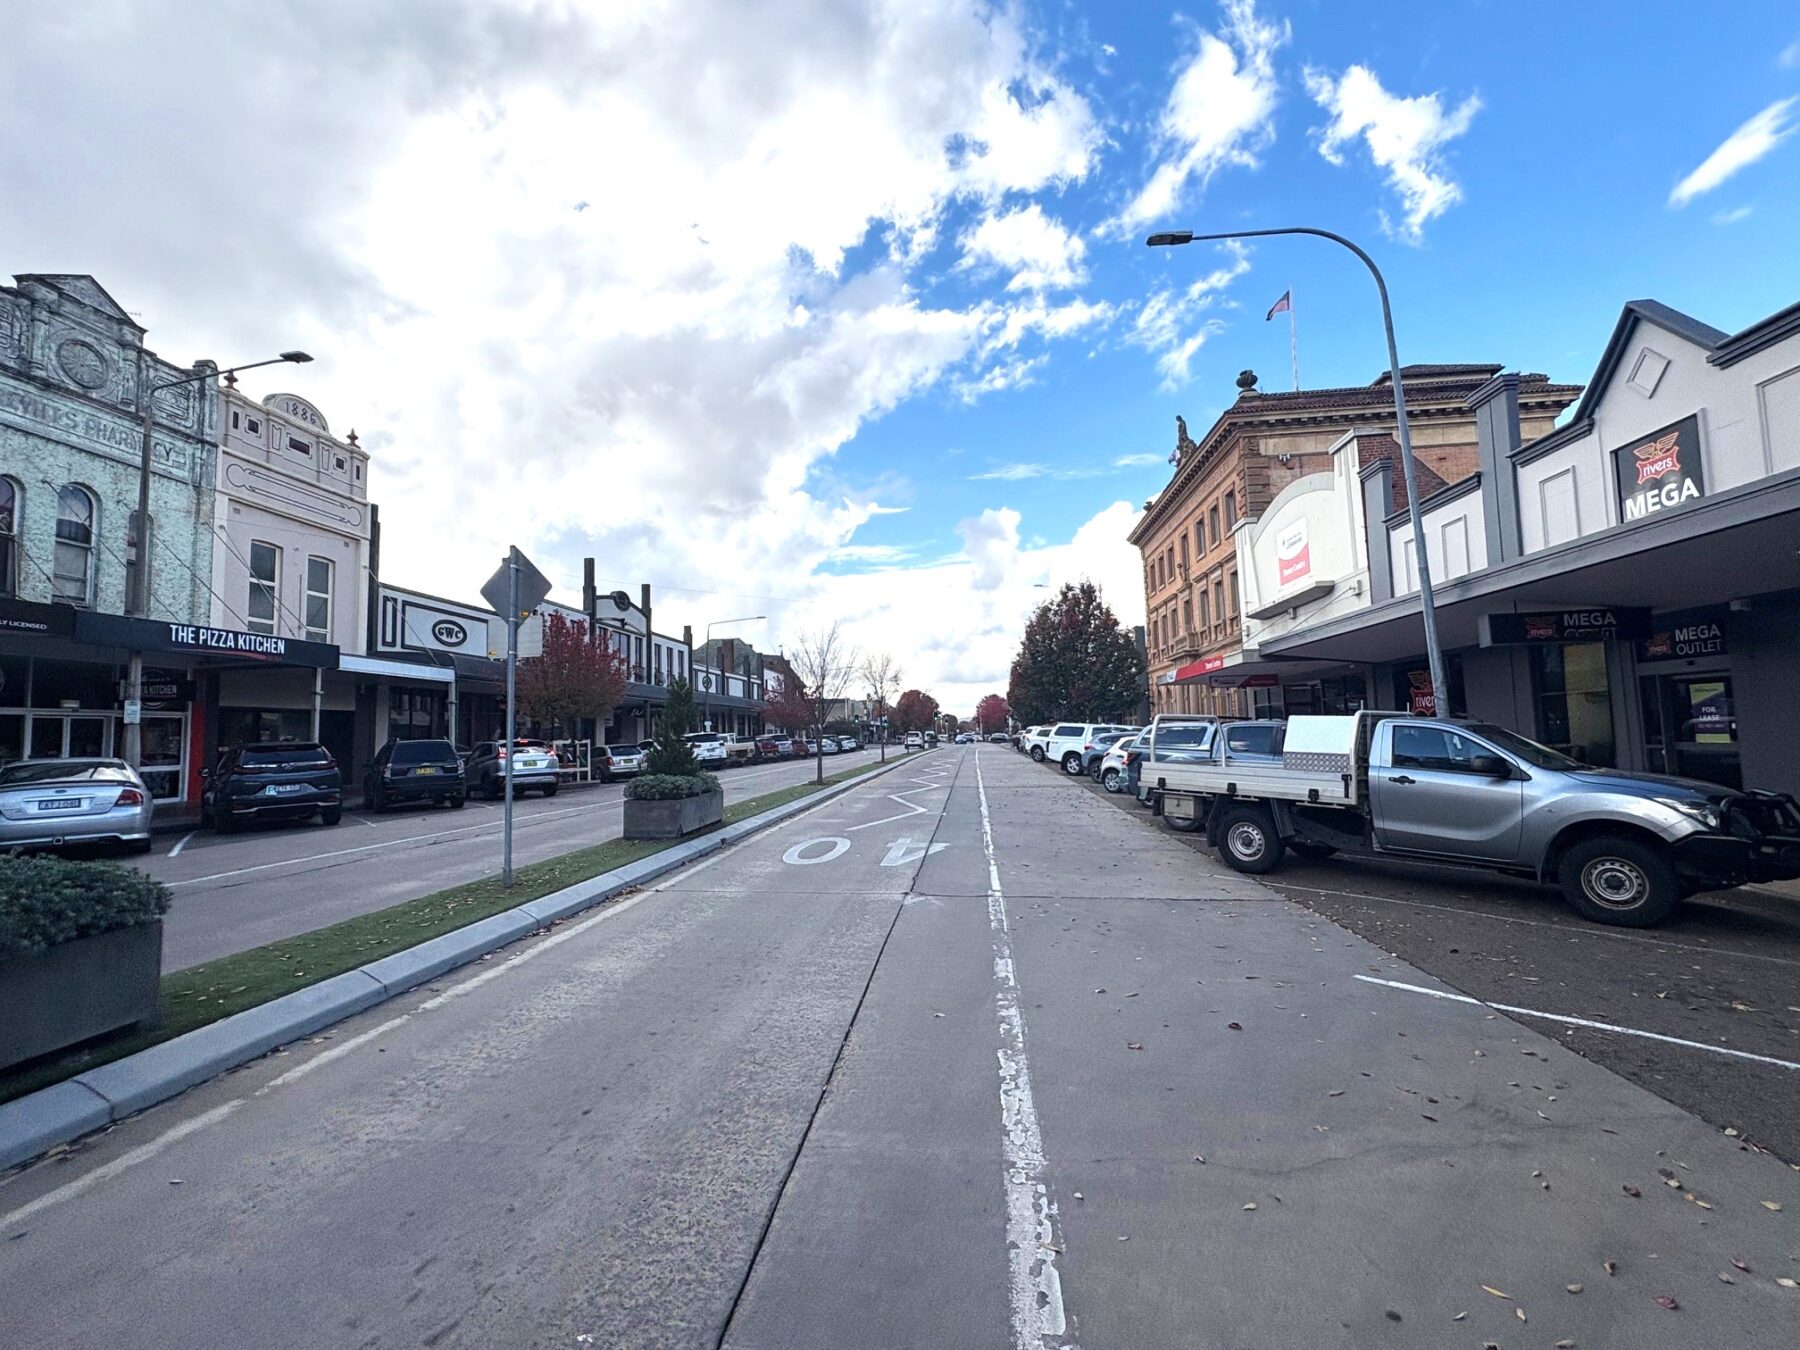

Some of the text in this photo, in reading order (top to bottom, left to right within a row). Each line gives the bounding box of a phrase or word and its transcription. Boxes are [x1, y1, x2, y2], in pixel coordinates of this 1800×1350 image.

[285, 401, 317, 425] 1886
[84, 419, 173, 462] PHARMCY
[1643, 457, 1673, 477] rivers
[1624, 477, 1700, 520] MEGA
[9, 620, 47, 630] LICENSED
[1563, 612, 1617, 626] MEGA
[169, 624, 285, 654] THE PIZZA KITCHEN
[1675, 624, 1721, 642] MEGA
[1676, 638, 1722, 655] OUTLET
[1415, 694, 1435, 708] river
